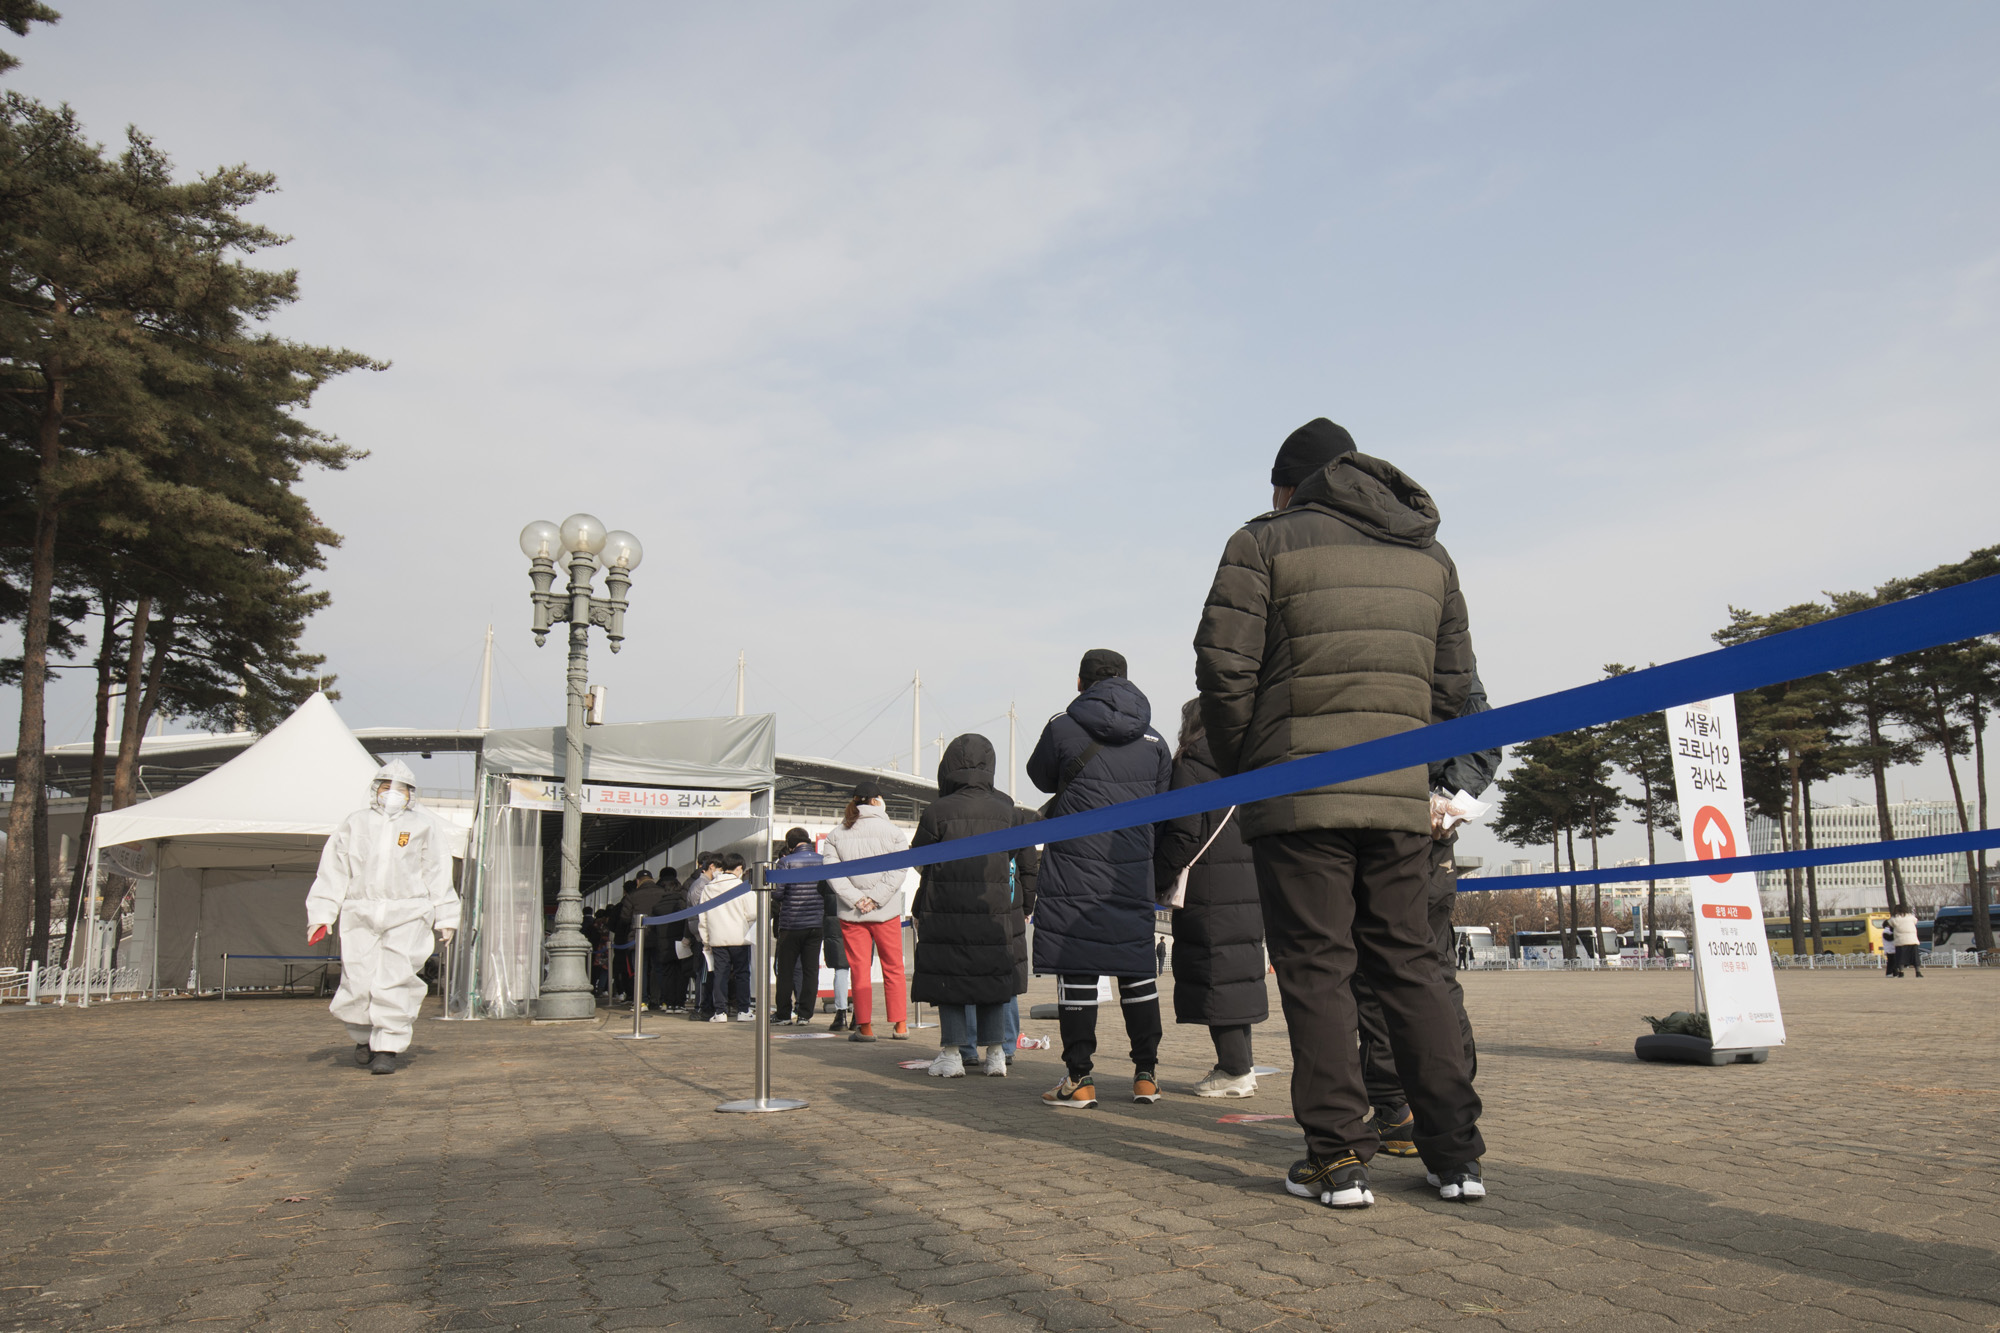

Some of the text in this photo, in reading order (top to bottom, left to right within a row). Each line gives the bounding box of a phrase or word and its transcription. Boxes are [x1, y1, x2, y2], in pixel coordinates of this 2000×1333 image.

[1685, 711, 1722, 740] 서울시
[1678, 737, 1730, 765] 코로나19
[1691, 766, 1728, 792] 검사소
[599, 790, 670, 806] 코로나19
[677, 793, 722, 808] 검사소
[1727, 906, 1739, 918] 시간
[1708, 941, 1758, 956] 13:00~21:00
